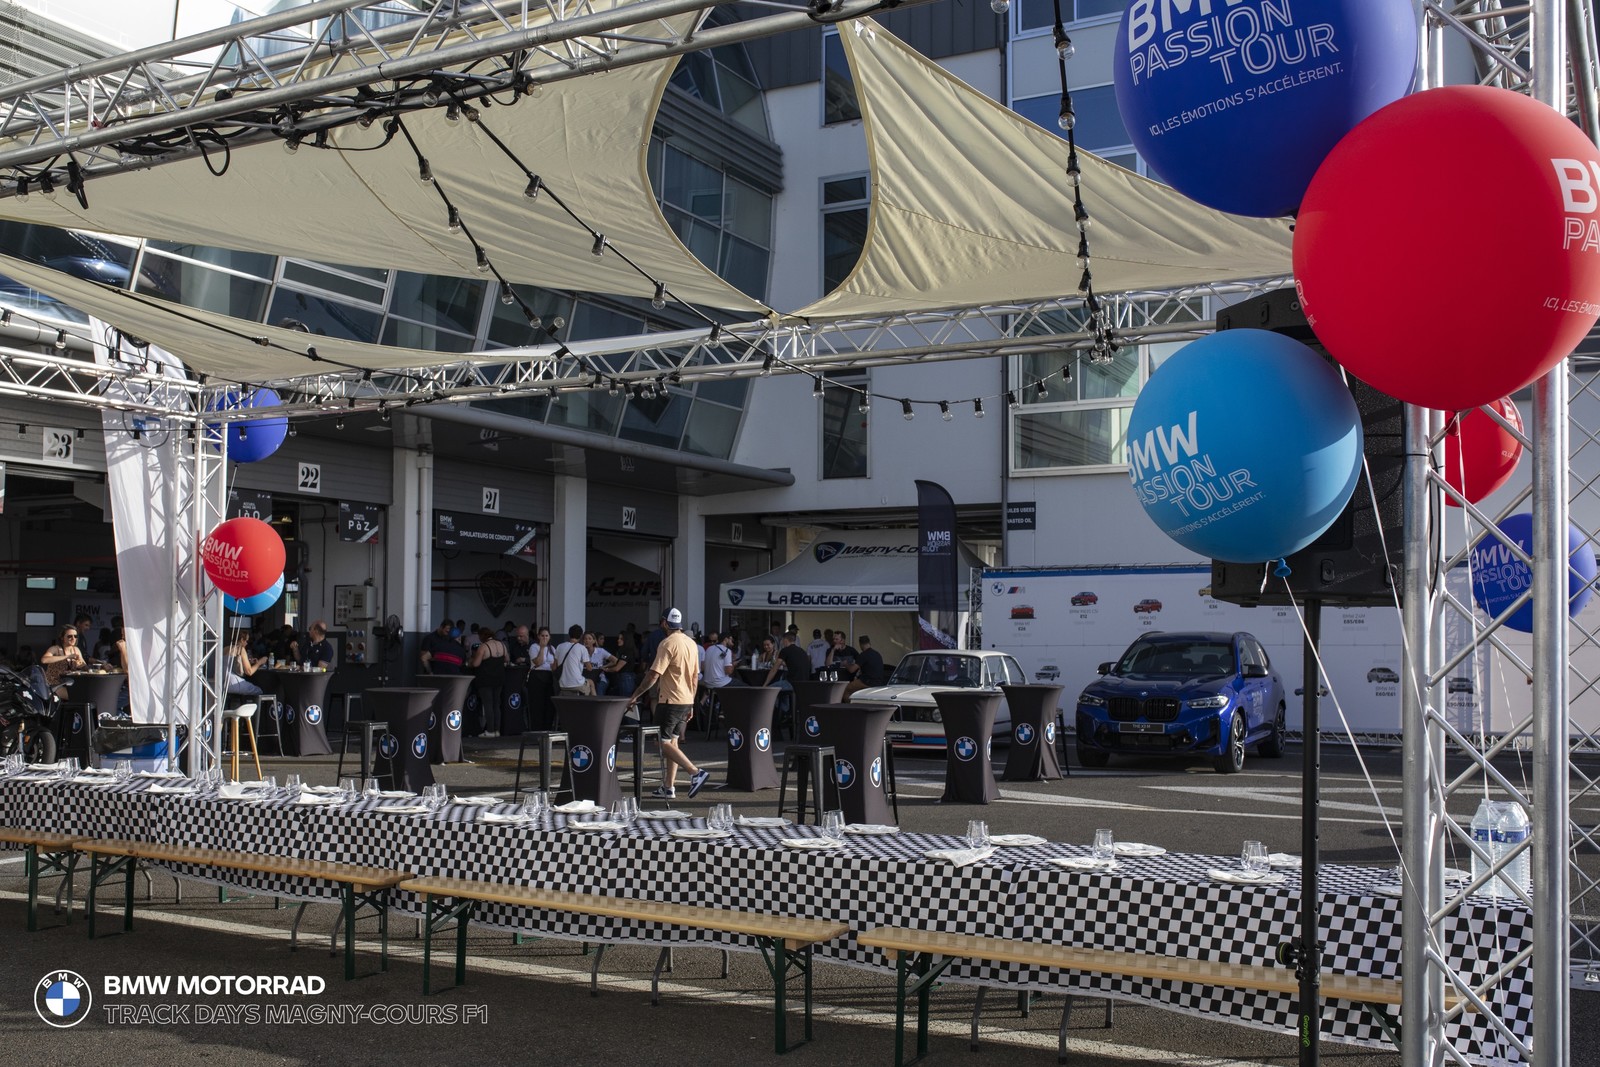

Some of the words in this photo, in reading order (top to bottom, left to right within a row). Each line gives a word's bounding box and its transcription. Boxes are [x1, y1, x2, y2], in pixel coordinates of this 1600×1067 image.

[1130, 0, 1293, 86] PASSION
[1209, 23, 1340, 85] TOUR
[1161, 115, 1182, 133] LES
[1180, 92, 1245, 125] ÉMOTIONS
[1245, 62, 1344, 101] S'ACCÉLÈRENT.
[1543, 296, 1560, 312] ICI,
[1561, 299, 1581, 313] LES
[44, 432, 72, 459] 23
[1126, 410, 1199, 484] BMW
[300, 466, 319, 489] 22
[484, 490, 498, 510] 21
[1169, 468, 1258, 517] TOUR
[348, 520, 354, 530] P
[356, 520, 362, 531] à
[364, 522, 370, 531] Z
[623, 509, 636, 527] 20
[460, 530, 488, 539] SIMULATEURS
[733, 525, 742, 540] 19
[205, 536, 243, 560] BMW
[842, 544, 918, 555] Magny-Co
[1471, 540, 1524, 572] BMW
[203, 551, 239, 570] PASSION
[217, 566, 249, 578] TOUR
[1496, 573, 1533, 593] TOU
[76, 605, 100, 615] BMW
